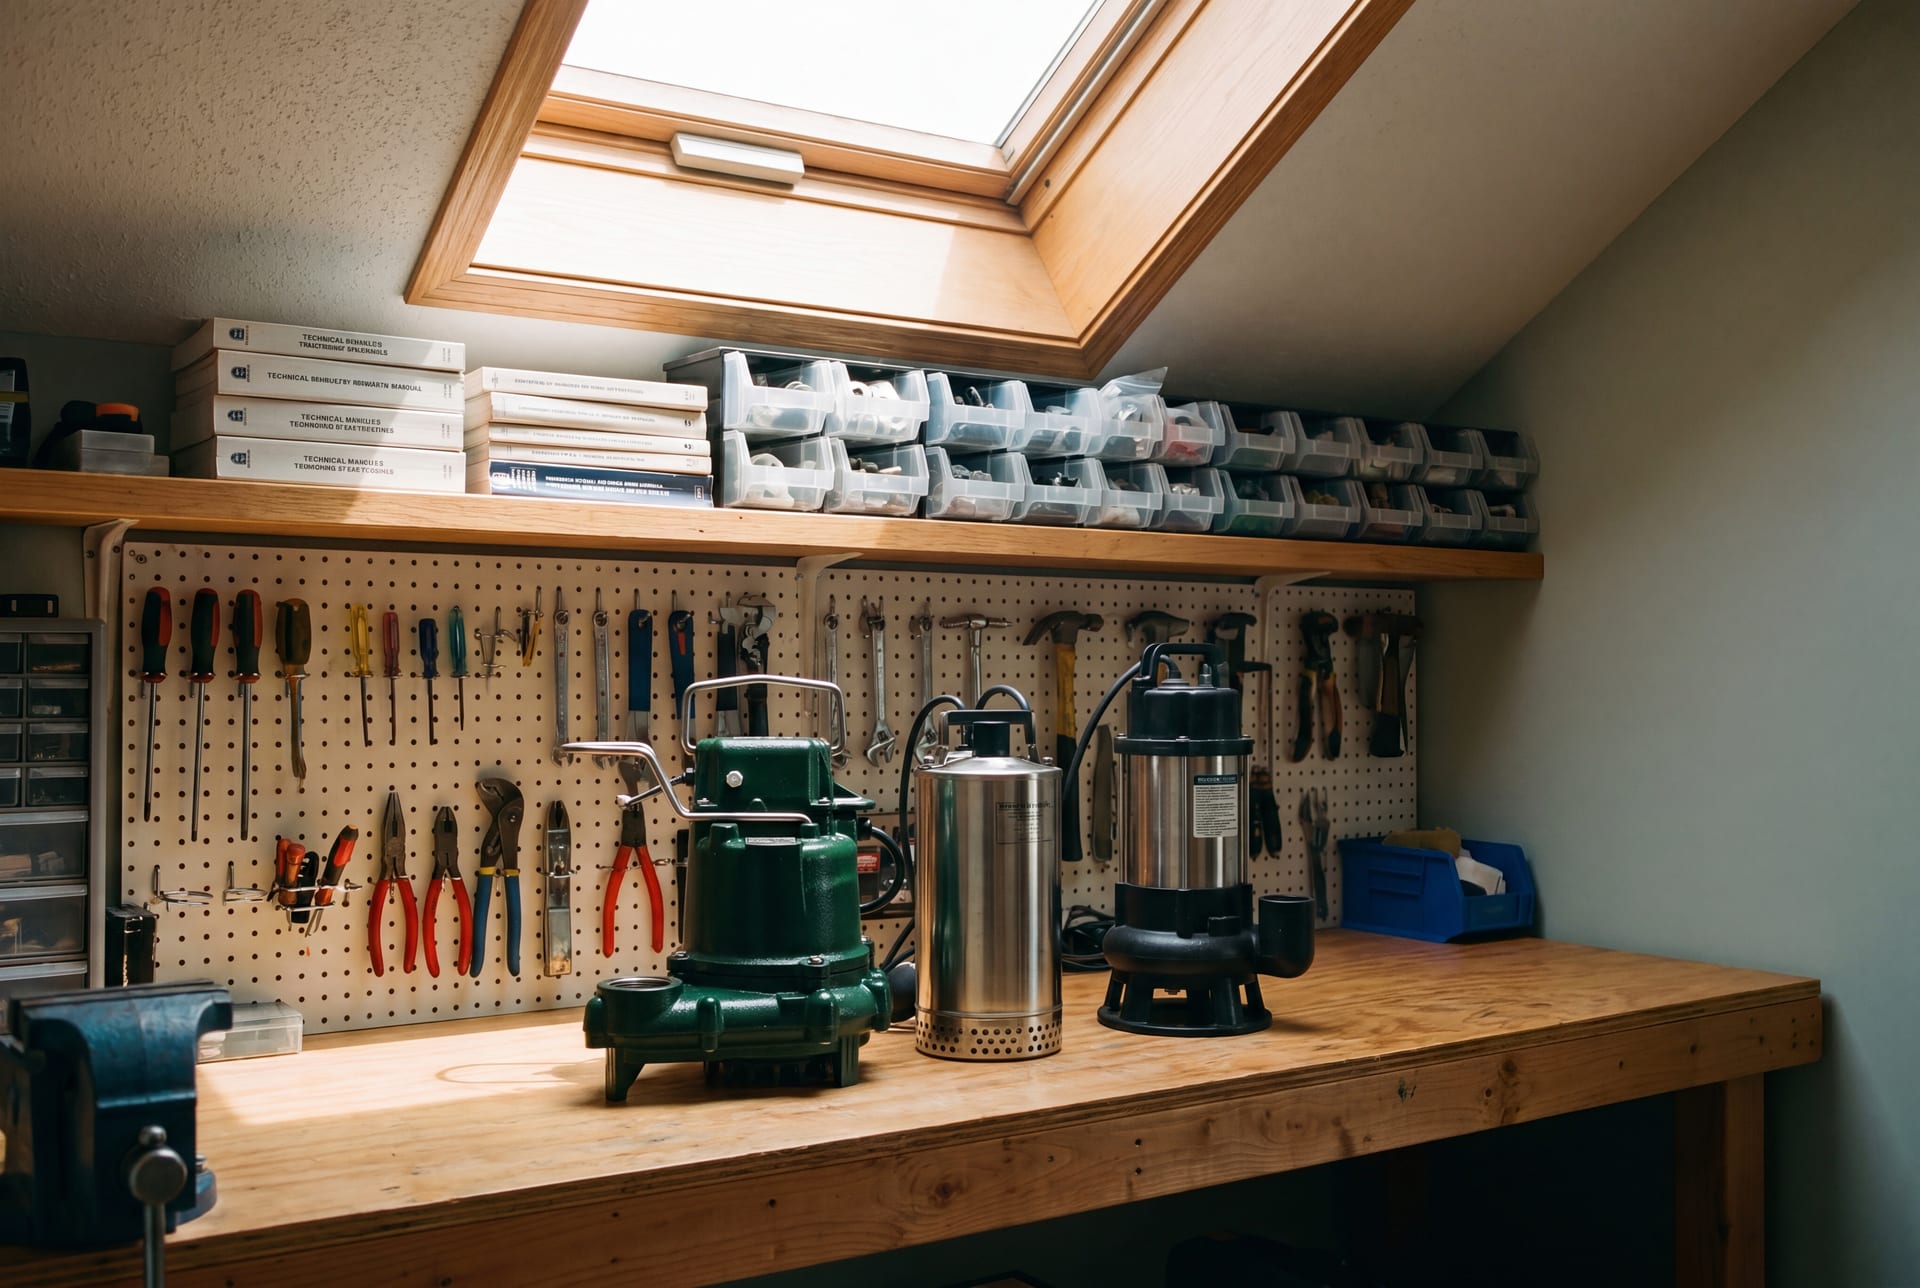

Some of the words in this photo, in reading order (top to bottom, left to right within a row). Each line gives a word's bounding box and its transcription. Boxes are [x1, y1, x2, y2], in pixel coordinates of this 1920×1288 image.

[302, 333, 345, 345] TECHNICAL
[267, 372, 309, 382] TECHNICAL
[300, 413, 345, 424] TECHNICAL
[303, 455, 347, 466] TECHNICAL
